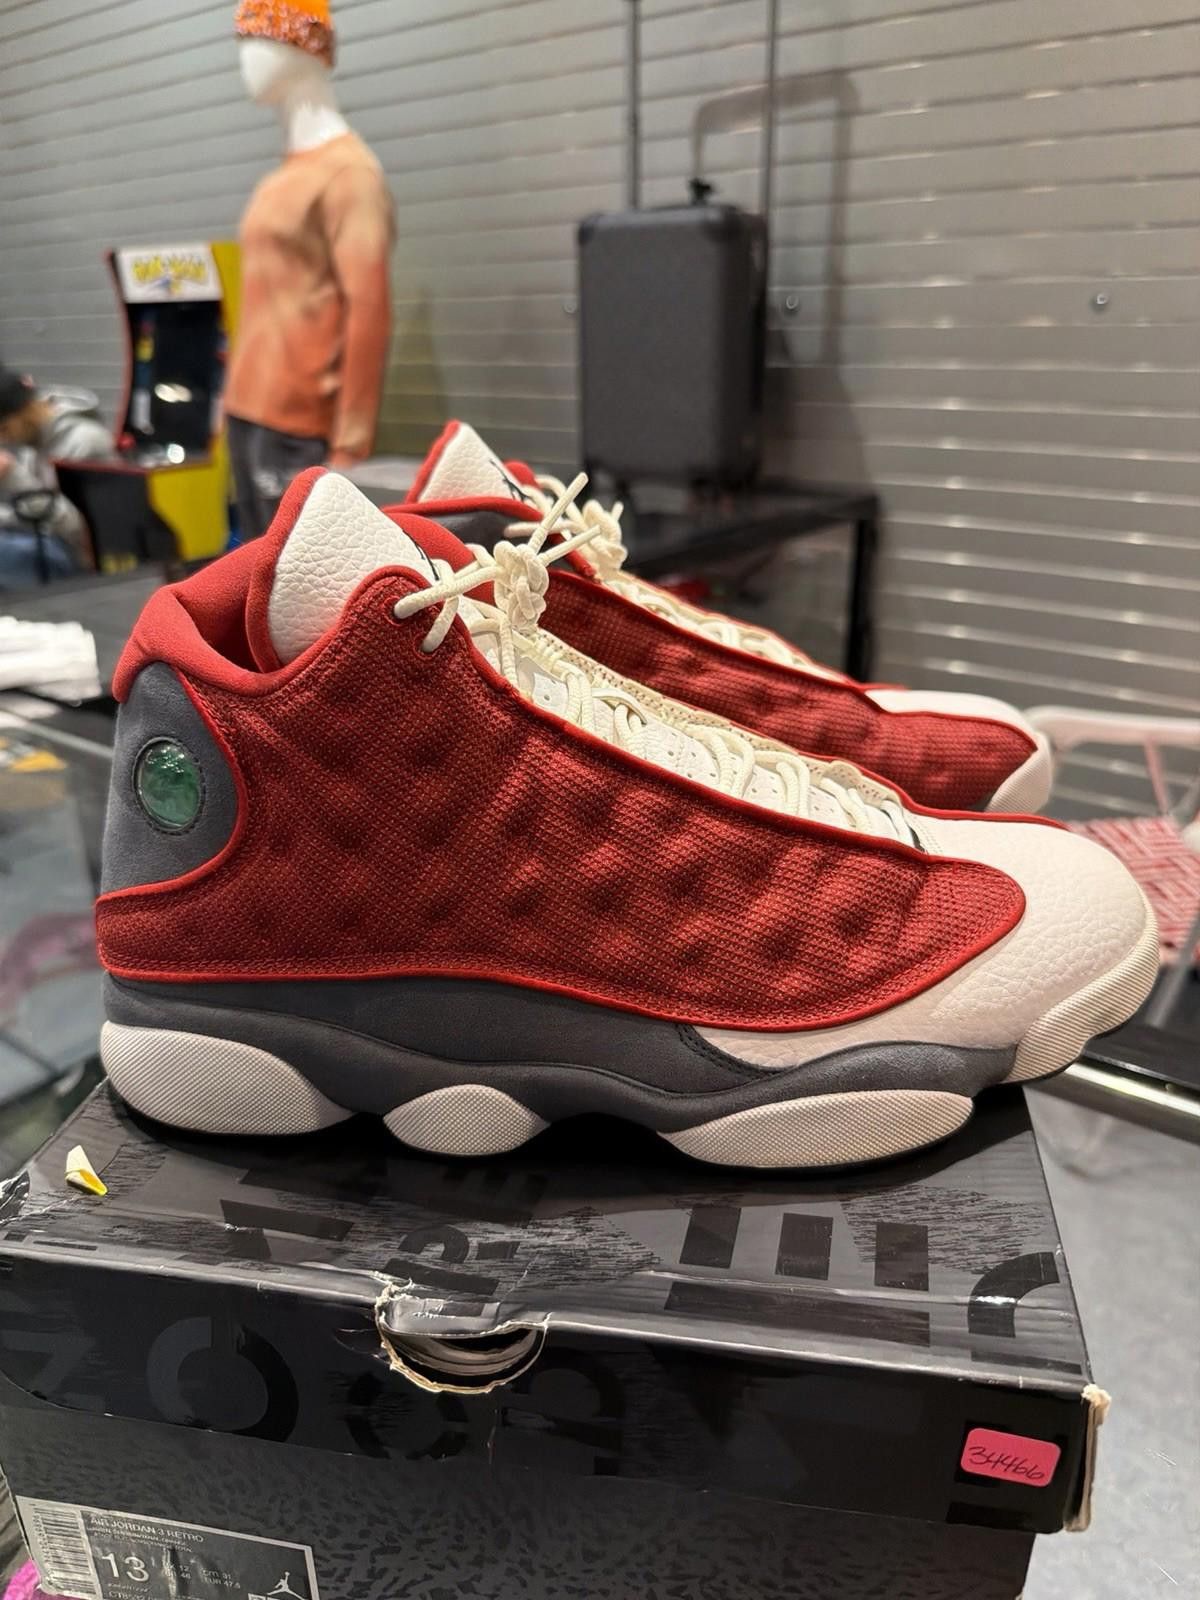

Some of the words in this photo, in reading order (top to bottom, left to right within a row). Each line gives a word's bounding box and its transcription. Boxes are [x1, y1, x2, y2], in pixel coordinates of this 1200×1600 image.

[968, 1446, 1045, 1480] 34466
[111, 1521, 156, 1535] JORDAN
[101, 1552, 150, 1582] 13
